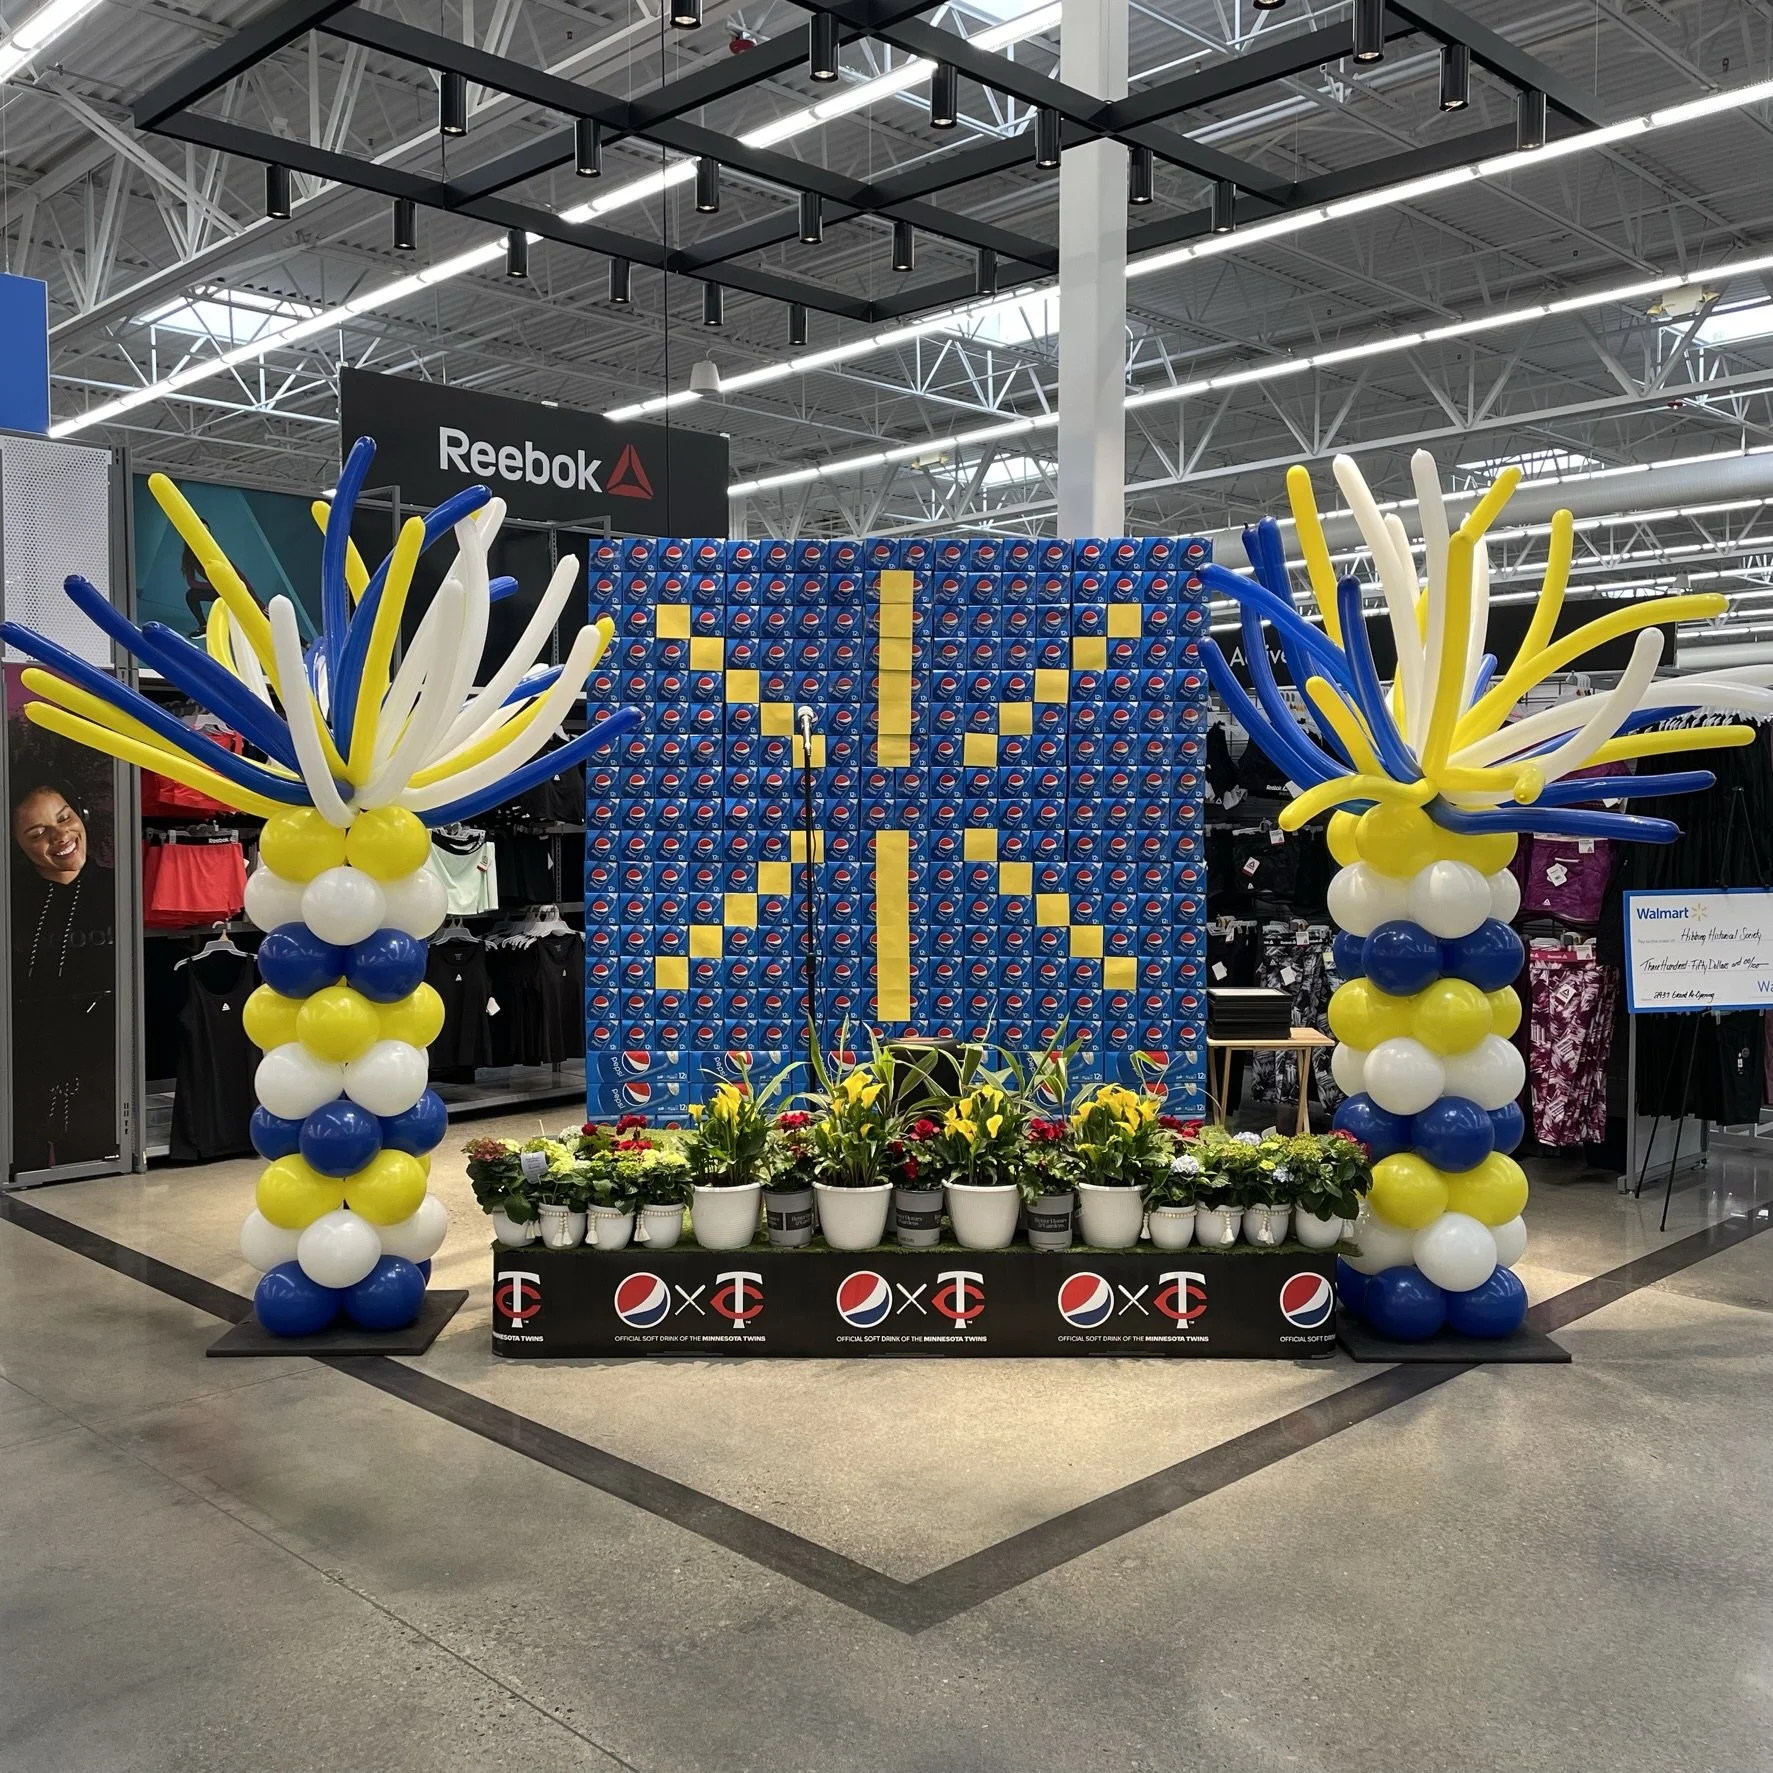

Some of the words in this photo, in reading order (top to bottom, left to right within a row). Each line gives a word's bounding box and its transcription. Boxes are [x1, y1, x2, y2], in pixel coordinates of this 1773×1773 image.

[439, 426, 602, 493] Reebok
[1636, 907, 1688, 920] Walmart
[1708, 926, 1738, 941] Historical
[1740, 927, 1762, 945] Society
[610, 1056, 624, 1078] pepsi
[713, 1056, 728, 1077] pepsi
[611, 1088, 626, 1109] pepsi
